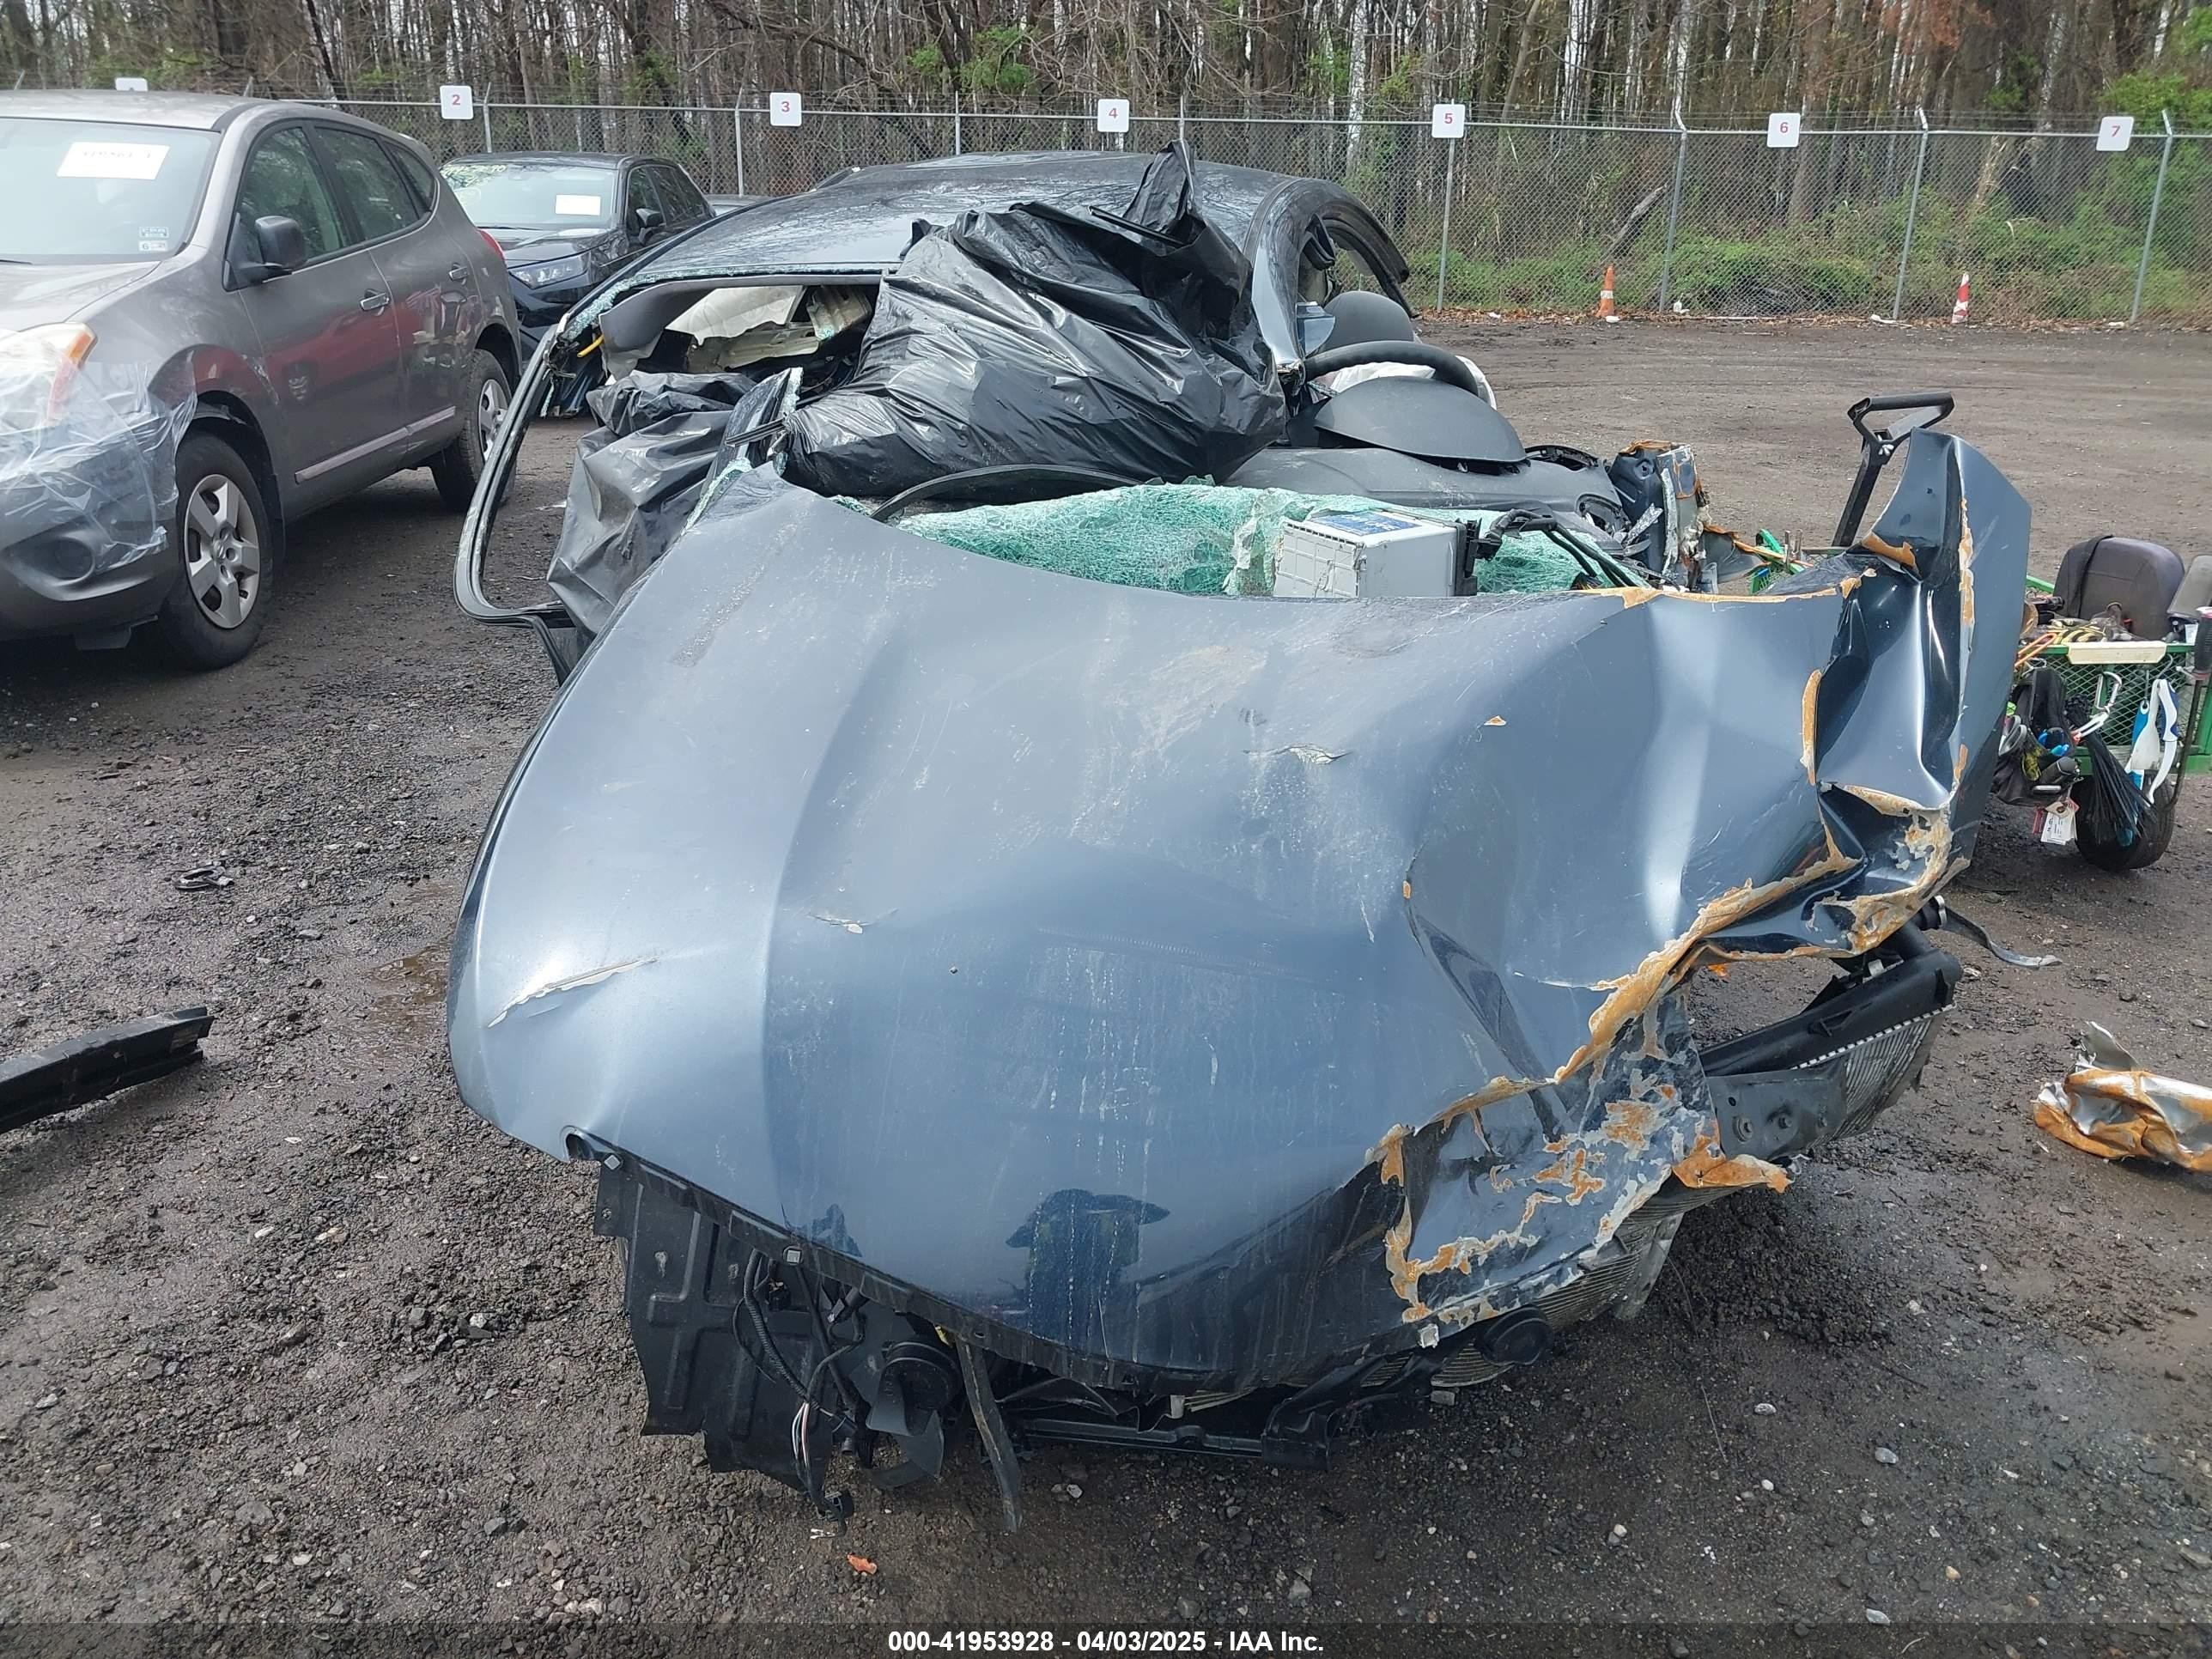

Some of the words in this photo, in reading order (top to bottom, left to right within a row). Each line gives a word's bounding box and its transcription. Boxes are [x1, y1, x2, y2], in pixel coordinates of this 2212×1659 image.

[452, 94, 461, 106] 2
[781, 100, 790, 112] 3
[1108, 107, 1119, 118] 4
[1444, 112, 1453, 125] 5
[1780, 121, 1789, 133] 6
[2112, 125, 2121, 137] 7
